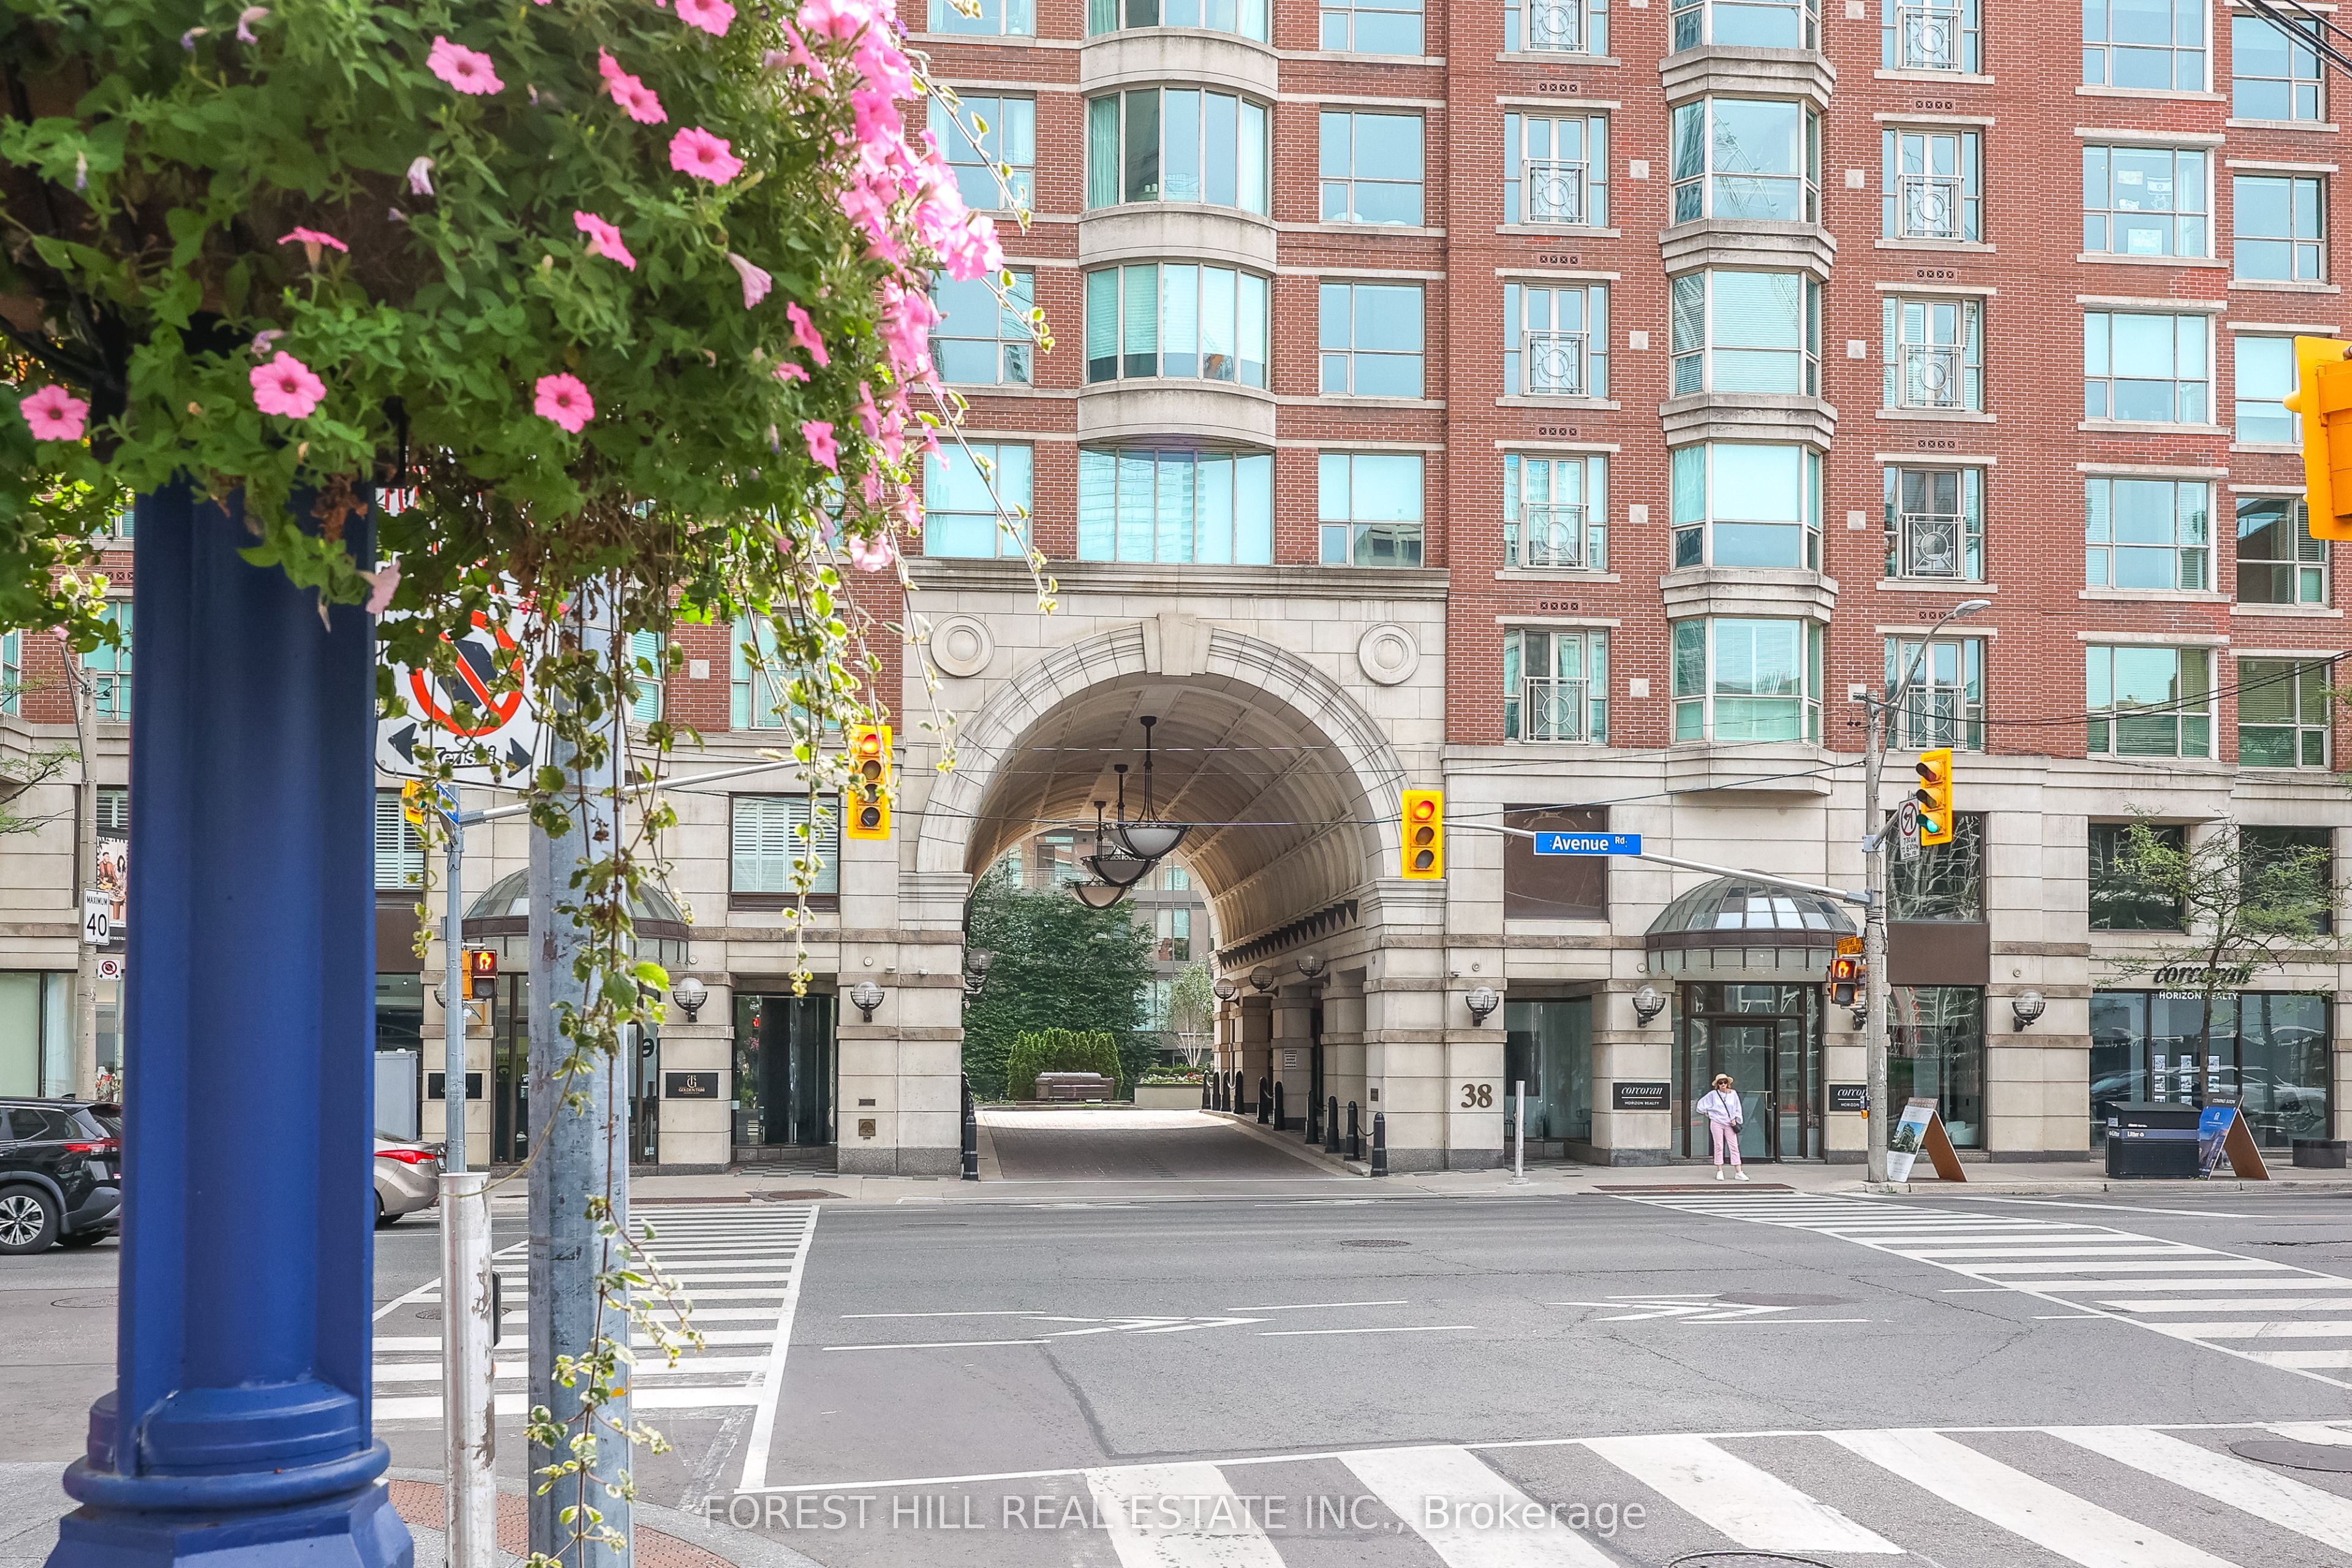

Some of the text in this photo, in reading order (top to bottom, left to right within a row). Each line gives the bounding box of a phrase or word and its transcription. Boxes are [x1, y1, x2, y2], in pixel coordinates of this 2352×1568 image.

[1552, 835, 1625, 851] Avenue Rd
[86, 895, 108, 905] MAXIMUM
[86, 913, 107, 937] 40
[1461, 1084, 1493, 1108] 38
